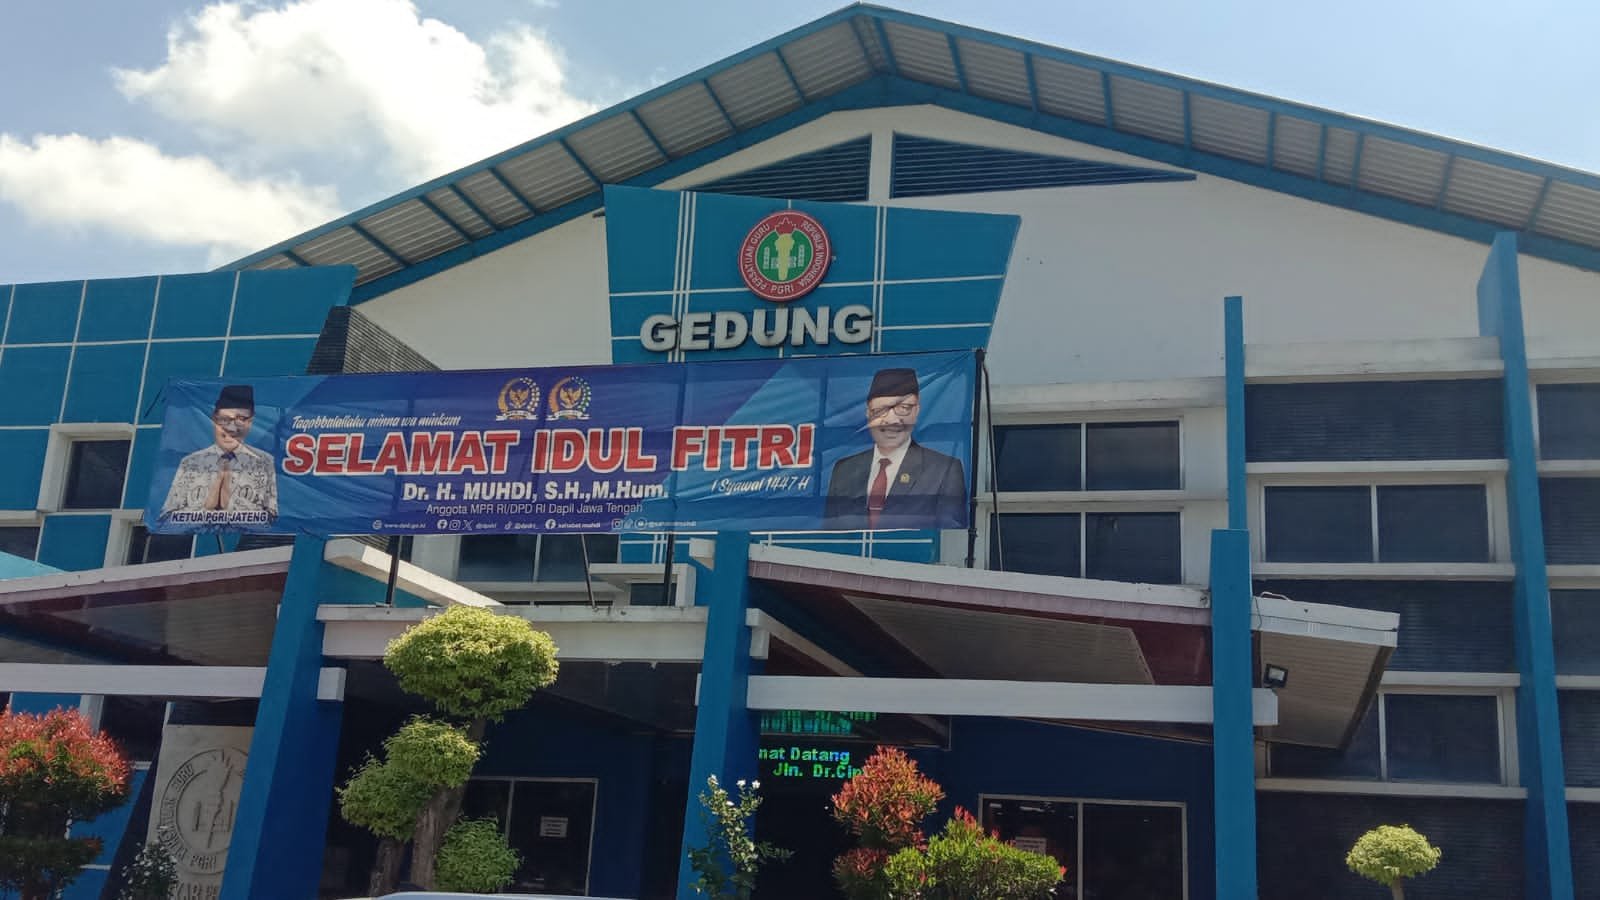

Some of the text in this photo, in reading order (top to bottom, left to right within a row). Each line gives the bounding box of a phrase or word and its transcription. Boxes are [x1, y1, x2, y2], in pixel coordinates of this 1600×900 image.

[750, 223, 770, 244] GURU
[744, 246, 767, 290] PERSATUAN
[799, 251, 825, 287] INDONESIA
[769, 284, 794, 294] PGRI
[640, 304, 873, 351] GEDUNG
[366, 413, 401, 428] minna
[400, 416, 418, 427] wa
[282, 423, 816, 476] SELAMAT IDUL FITRI
[403, 480, 669, 503] Dr. H. MUHDI, S.H.,M.Hum.
[719, 477, 764, 496] Syawal
[765, 475, 798, 492] 1447
[798, 475, 810, 490] H
[170, 510, 268, 524] KETUA PGRI JATENG
[426, 501, 643, 517] Anggota MPR RI/DPD RI Dapil Jawa Tengah
[790, 747, 850, 765] Datang
[772, 762, 803, 777] Jln.
